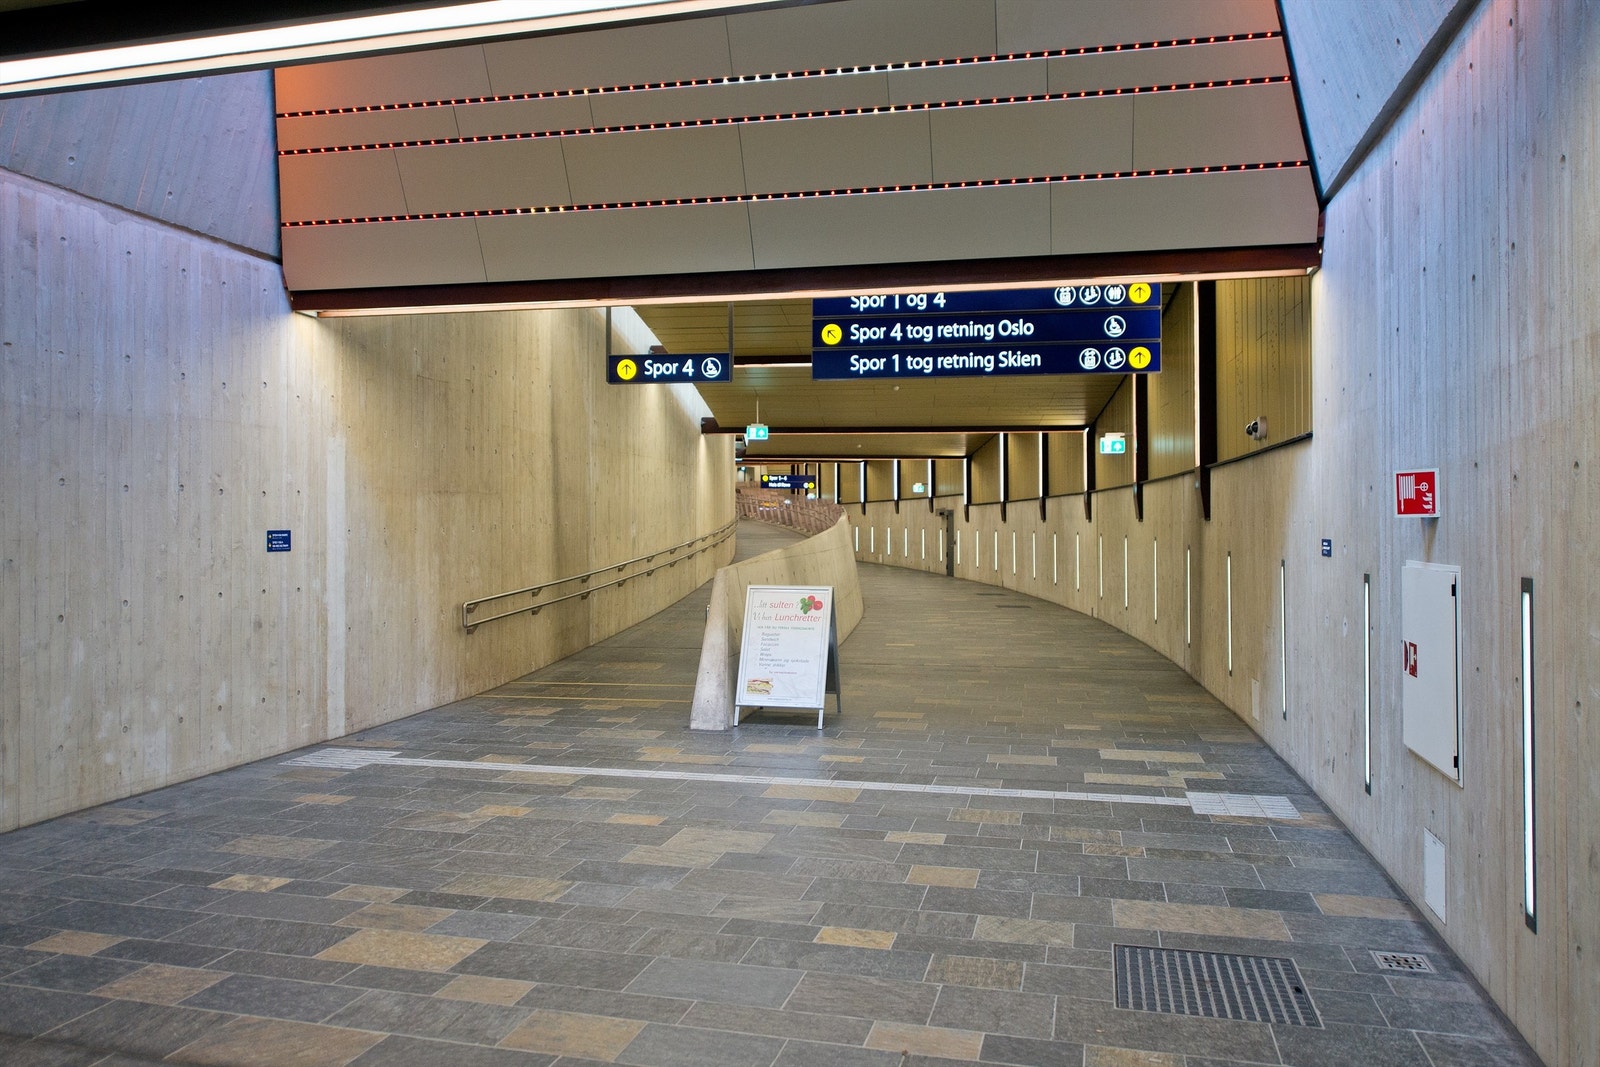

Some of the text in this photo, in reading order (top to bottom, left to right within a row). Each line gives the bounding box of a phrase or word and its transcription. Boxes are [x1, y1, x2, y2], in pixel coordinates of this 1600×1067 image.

[850, 292, 947, 312] Spor 1 og 4
[850, 318, 1035, 344] Spor 4 tog retning Oslo
[644, 358, 695, 379] Spor 4
[850, 350, 1042, 375] Spor 1 tog retning Skien
[769, 600, 794, 609] sulten
[774, 613, 822, 623] Lunchretter
